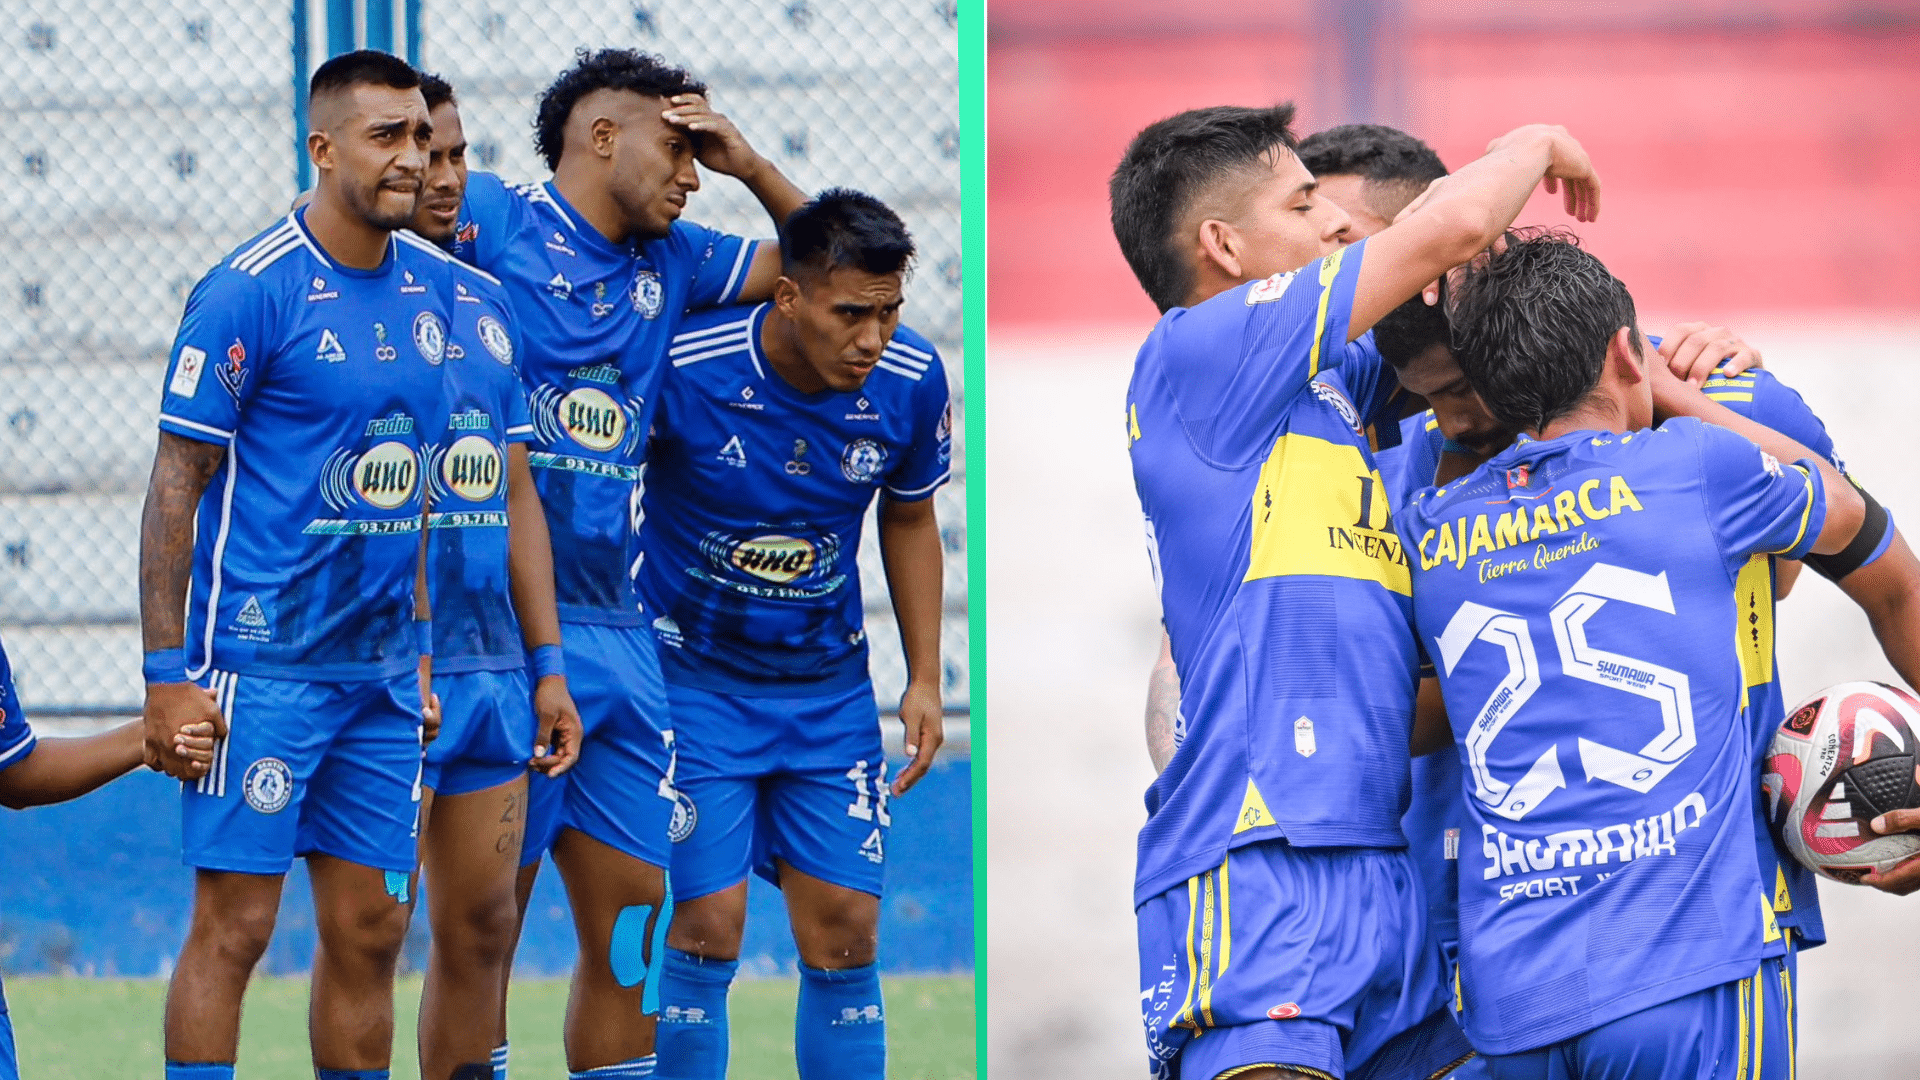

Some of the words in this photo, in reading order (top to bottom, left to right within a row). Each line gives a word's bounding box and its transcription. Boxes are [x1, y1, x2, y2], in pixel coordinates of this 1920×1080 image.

[365, 413, 414, 436] radio
[448, 409, 490, 430] radio
[566, 459, 599, 473] 93.7
[360, 521, 391, 533] 93.7
[452, 514, 481, 525] 93.7
[1418, 475, 1644, 571] CAJAMARCA
[1477, 554, 1530, 585] Tierra
[1533, 531, 1601, 571] Querida
[1596, 660, 1656, 685] SHUMAWA
[1433, 562, 1698, 822] 25
[1478, 686, 1513, 732] SHUMAWA
[1820, 733, 1837, 777] CONEXT24
[845, 760, 892, 828] 11
[1498, 875, 1582, 906] SPORT
